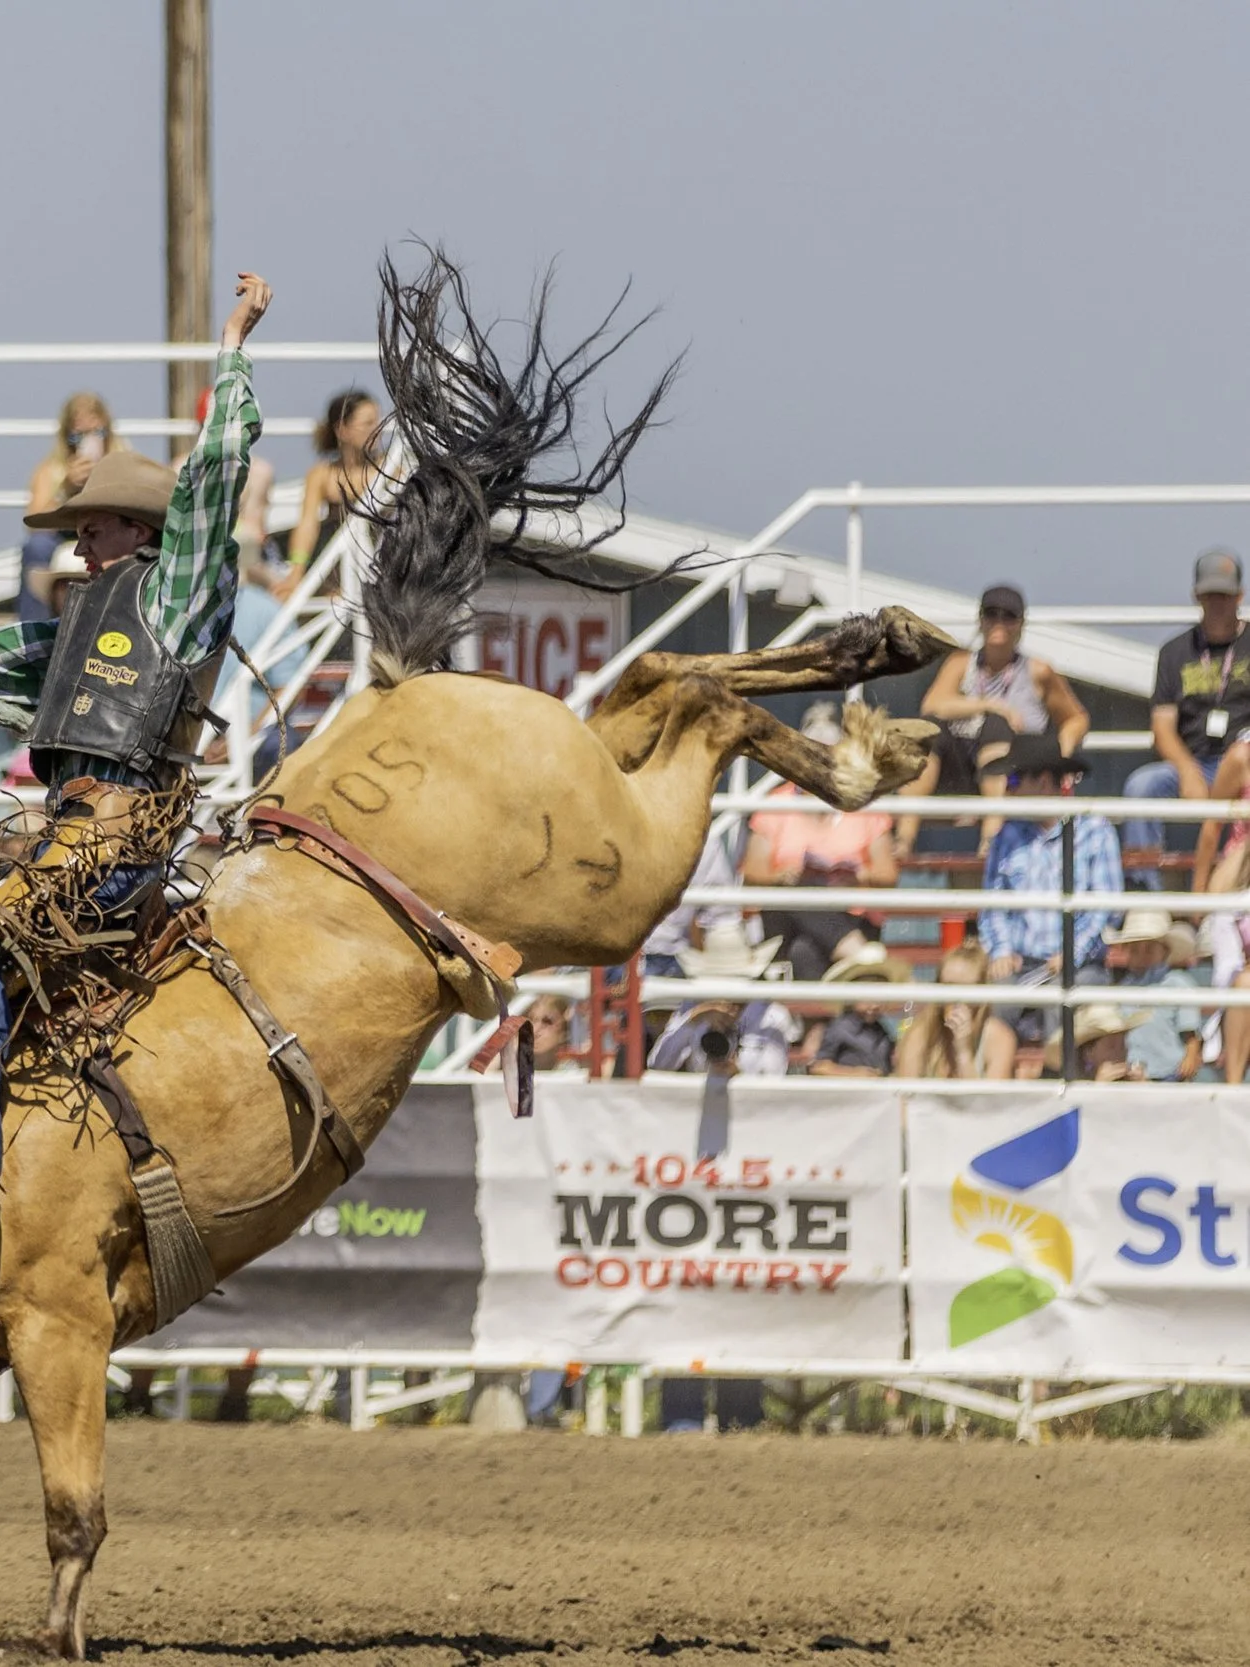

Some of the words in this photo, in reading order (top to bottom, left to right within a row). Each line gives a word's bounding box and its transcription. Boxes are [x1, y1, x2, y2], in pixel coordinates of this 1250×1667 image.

[88, 661, 136, 682] Wrangler
[633, 1154, 772, 1190] 104.5
[557, 1195, 849, 1251] MORE
[1117, 1176, 1250, 1267] St
[556, 1255, 849, 1293] COUNTRY
